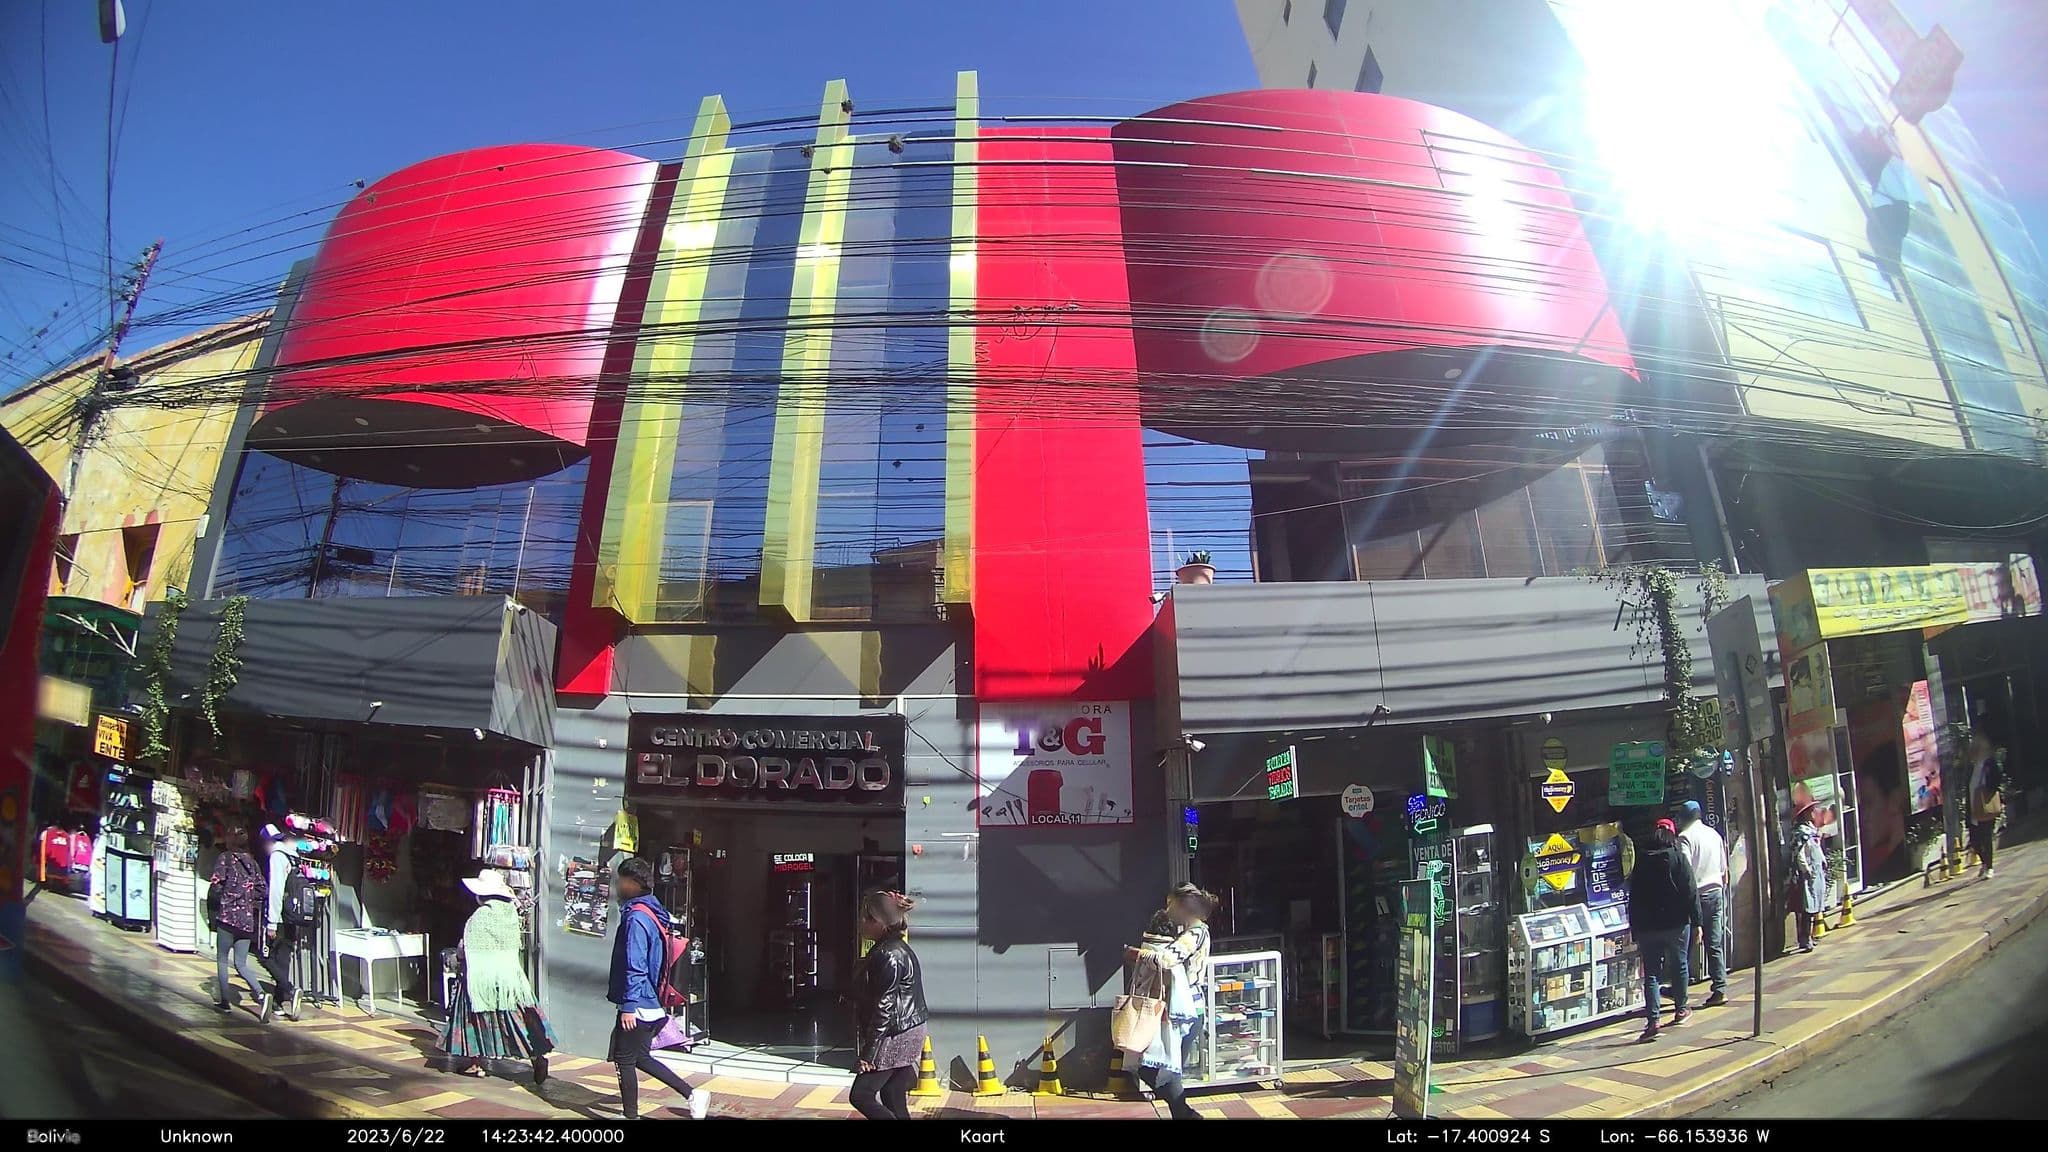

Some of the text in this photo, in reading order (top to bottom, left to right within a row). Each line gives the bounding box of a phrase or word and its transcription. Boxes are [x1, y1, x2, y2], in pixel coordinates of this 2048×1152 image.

[650, 727, 881, 752] CENTRO COMERCIAL
[637, 753, 890, 791] EL DORADO
[1032, 814, 1081, 824] LOCAL 11
[1414, 843, 1452, 861] VENTA DE
